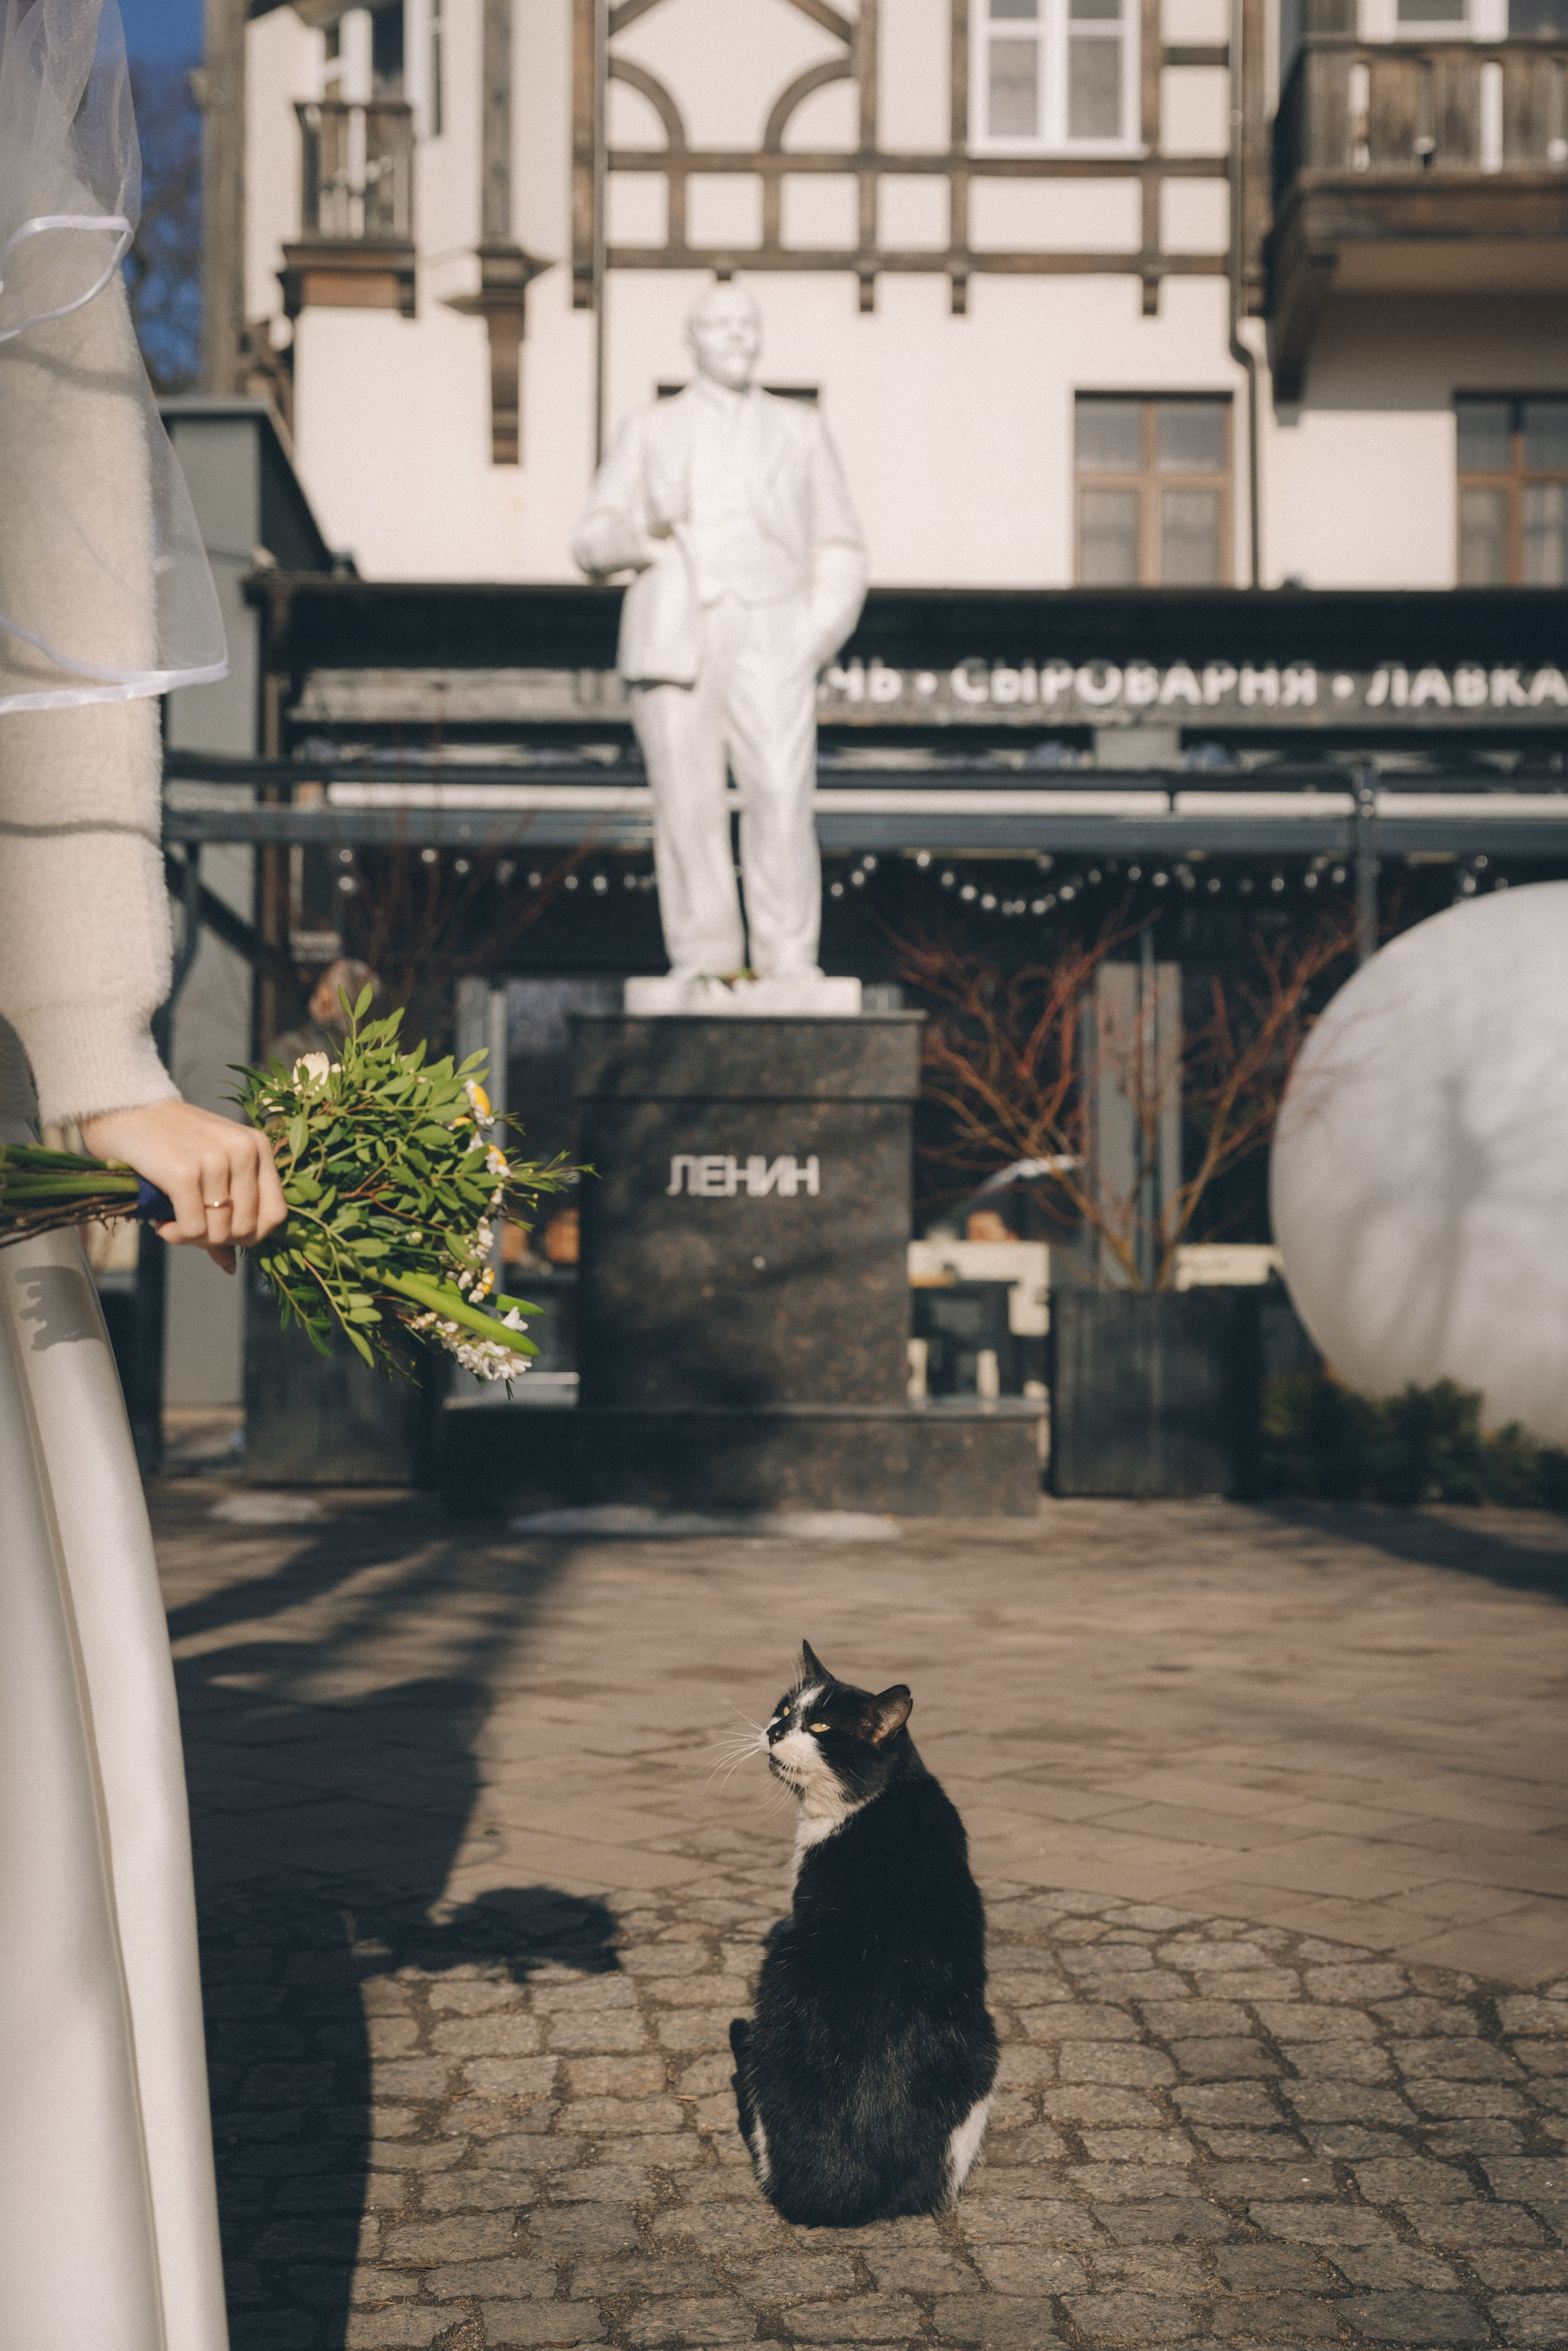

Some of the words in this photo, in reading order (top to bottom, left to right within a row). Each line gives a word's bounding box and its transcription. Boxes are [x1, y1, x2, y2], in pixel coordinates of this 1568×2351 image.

[817, 657, 903, 703] ЧЬ
[949, 657, 1317, 705] СЫРОВАРНЯ
[1365, 660, 1568, 707] ЛАВКА
[666, 1154, 820, 1197] ЛЕНИН
